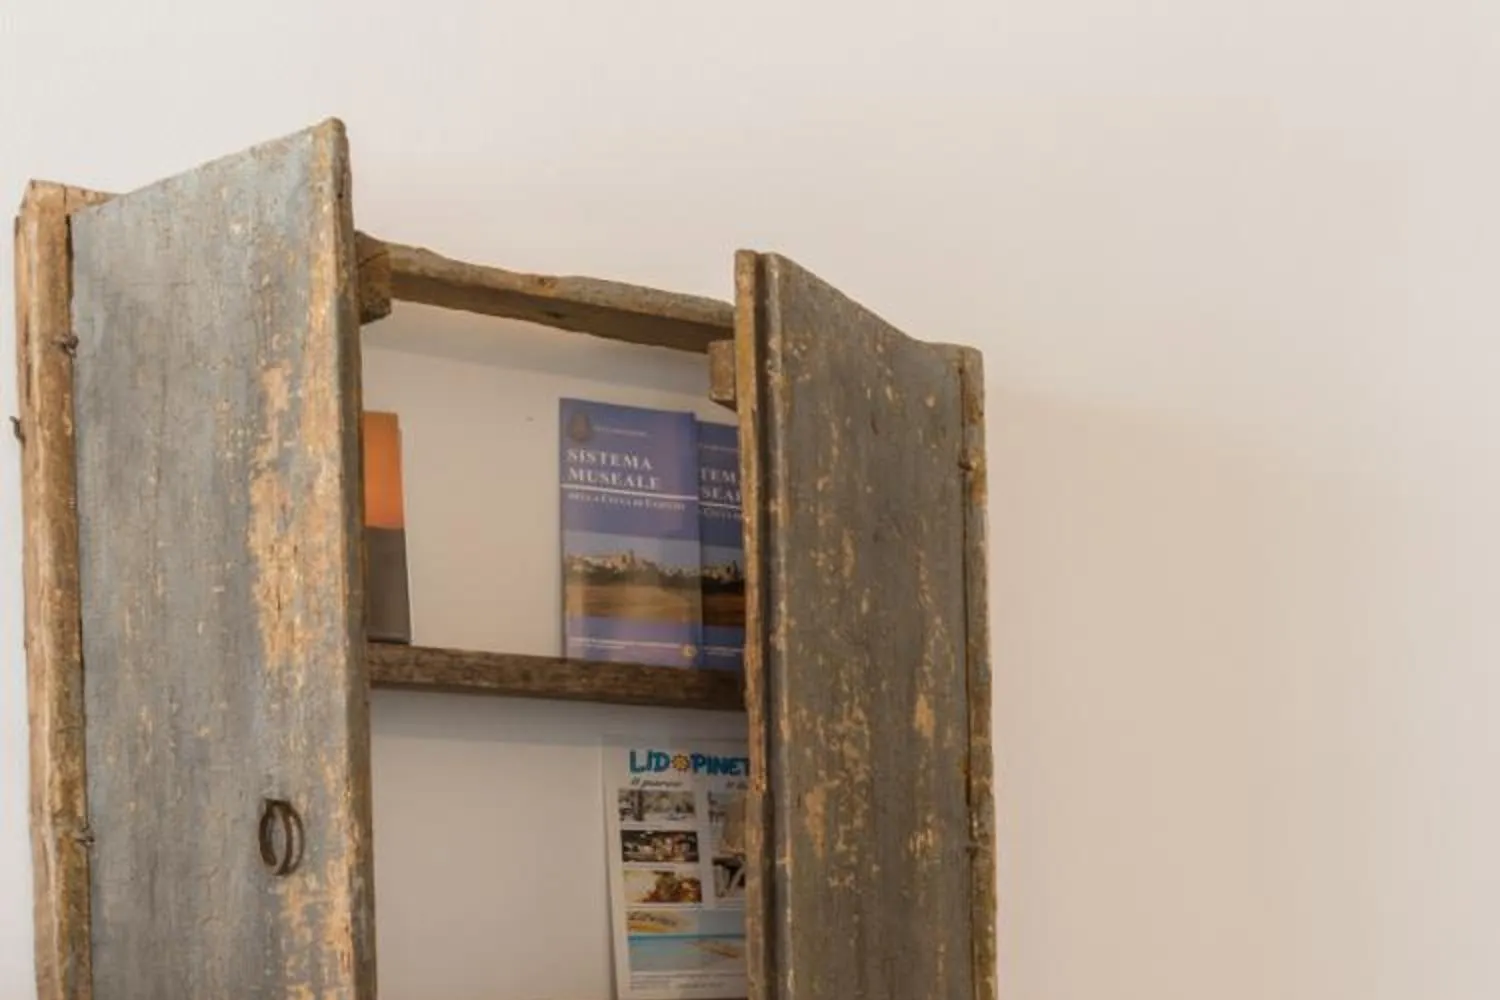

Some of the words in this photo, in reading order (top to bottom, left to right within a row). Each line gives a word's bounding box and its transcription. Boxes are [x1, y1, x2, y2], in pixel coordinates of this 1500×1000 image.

[567, 448, 654, 471] SISTEMA
[568, 467, 660, 490] MUSEALE
[690, 753, 749, 776] PINET
